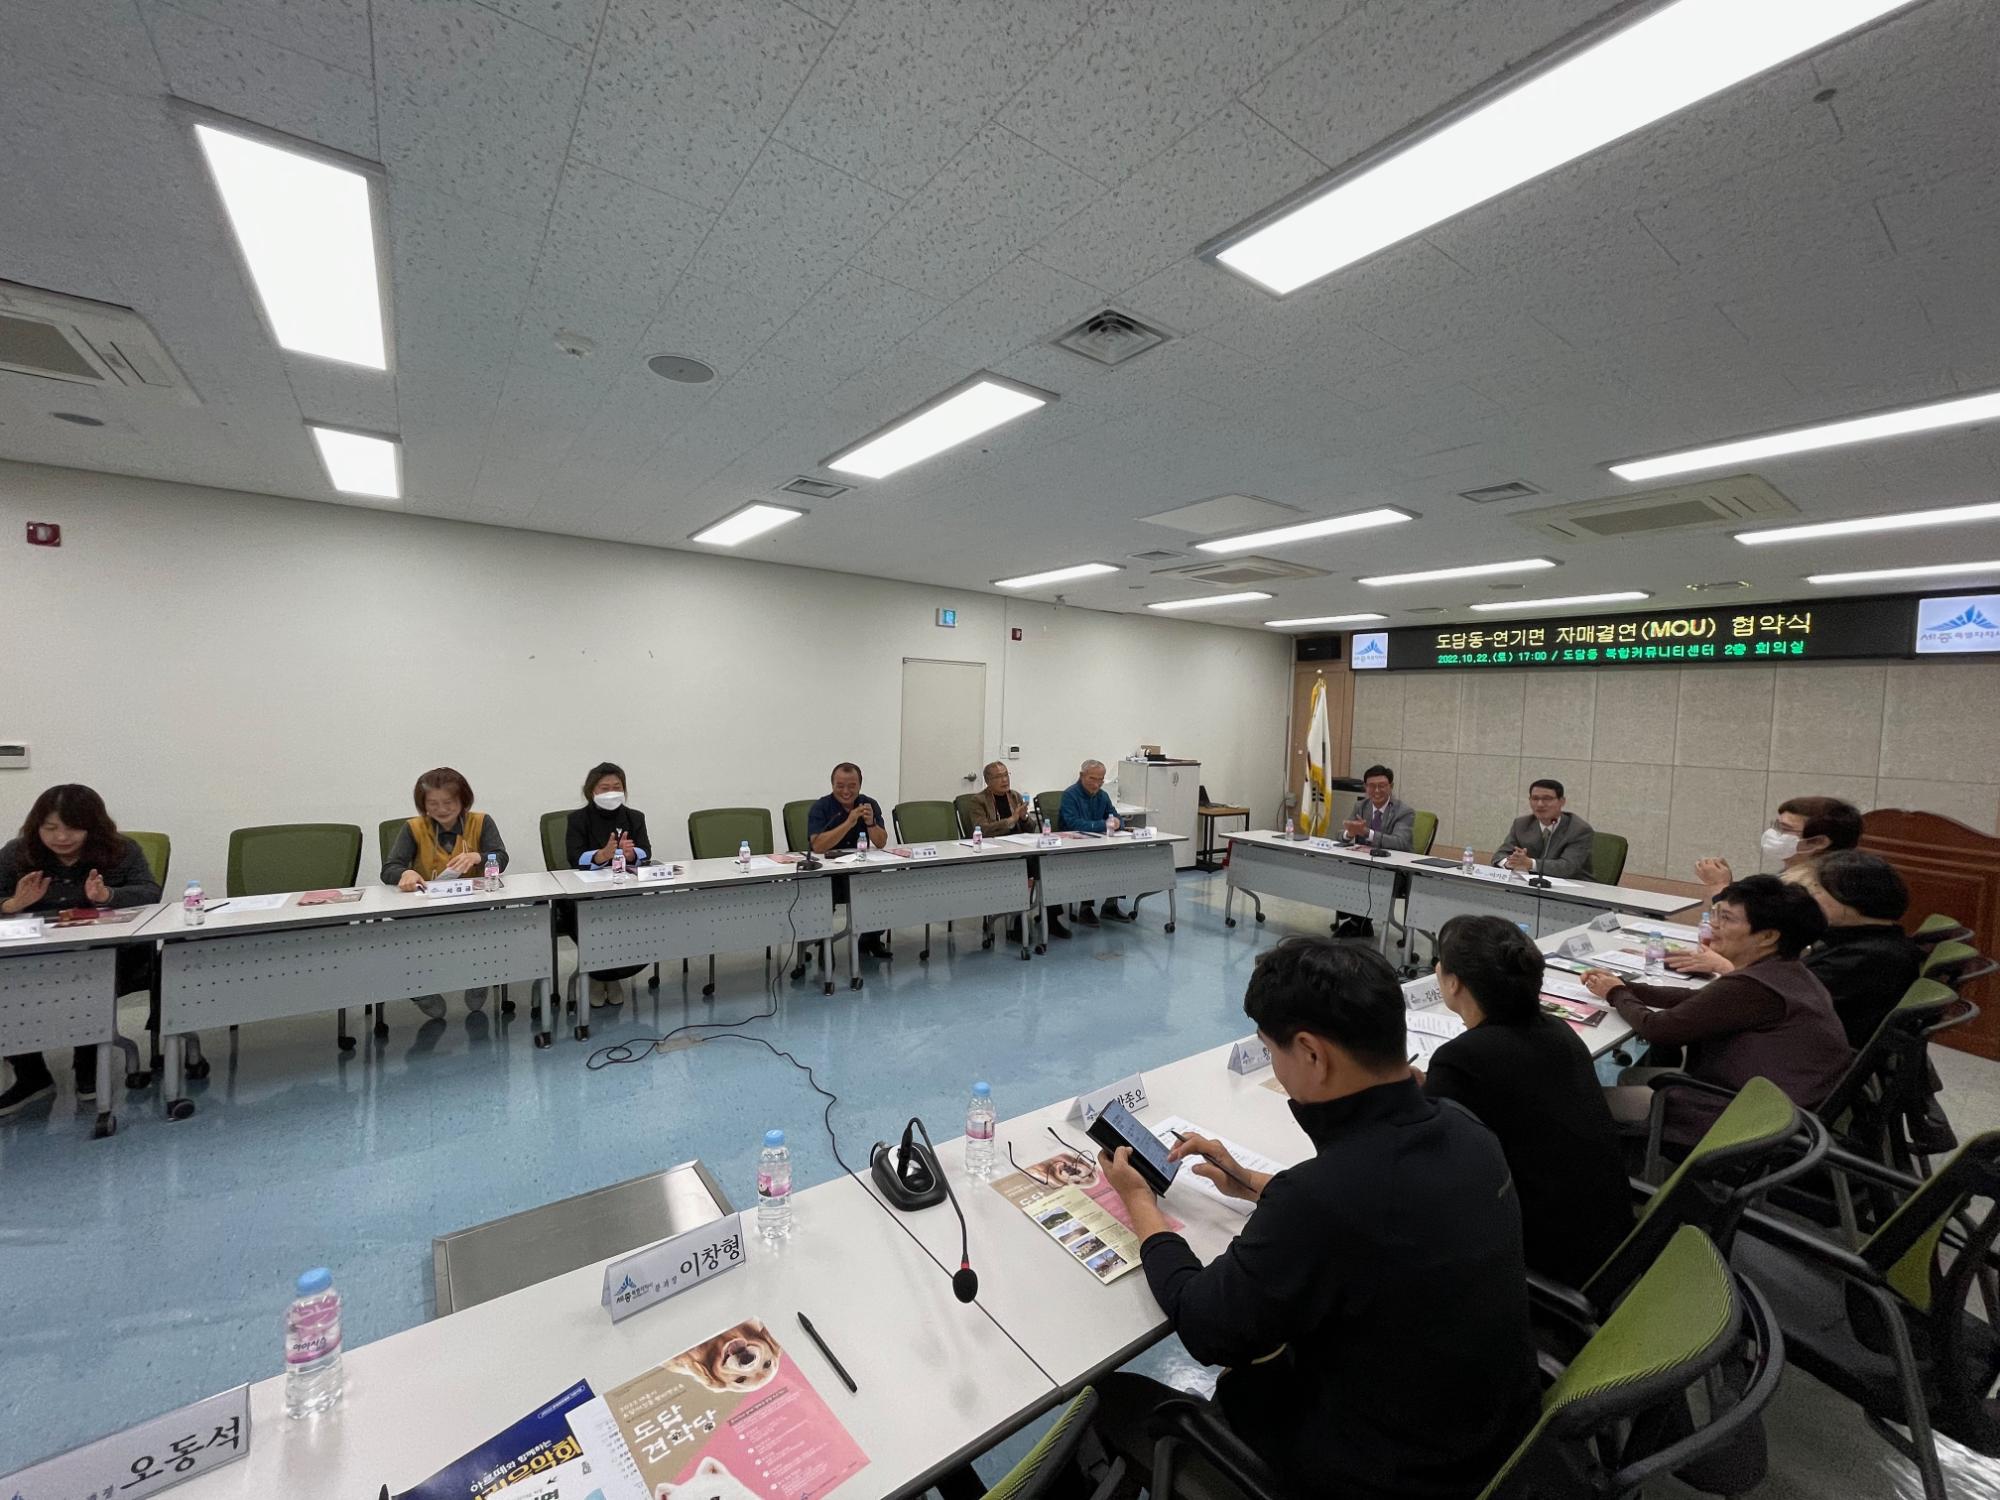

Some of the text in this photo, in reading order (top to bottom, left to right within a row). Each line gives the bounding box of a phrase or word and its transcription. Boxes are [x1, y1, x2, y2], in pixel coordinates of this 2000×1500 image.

[1436, 612, 1811, 650] 도담동-연기면 자매결연(MOU) 협약식
[1519, 651, 1547, 662] 17:00
[1563, 649, 1598, 661] 도담동
[1606, 644, 1714, 659] 복합커뮤니티센터
[1756, 640, 1804, 655] 회의실
[680, 1234, 740, 1277] 이창형
[120, 1416, 240, 1490] 오동석
